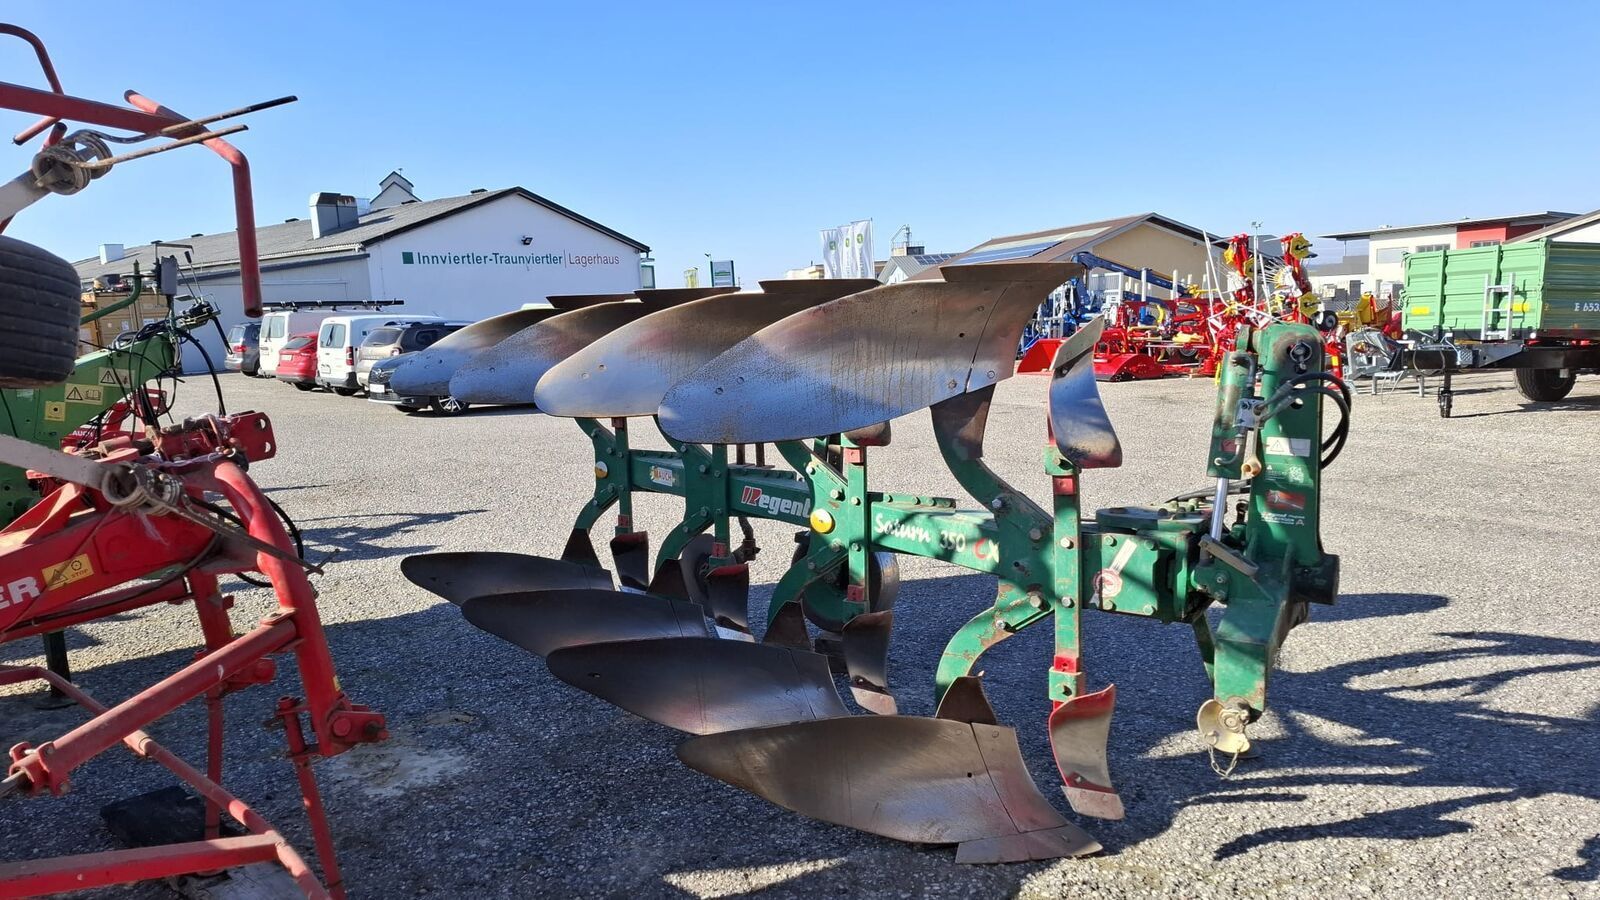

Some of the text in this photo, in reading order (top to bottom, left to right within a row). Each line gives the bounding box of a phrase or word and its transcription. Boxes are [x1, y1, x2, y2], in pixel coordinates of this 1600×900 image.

[417, 251, 620, 268] Innviertler-Traunviertler Lagerhaus
[1583, 302, 1600, 312] 653
[741, 485, 811, 518] Regent
[875, 512, 931, 543] Saturn
[939, 529, 966, 553] 350
